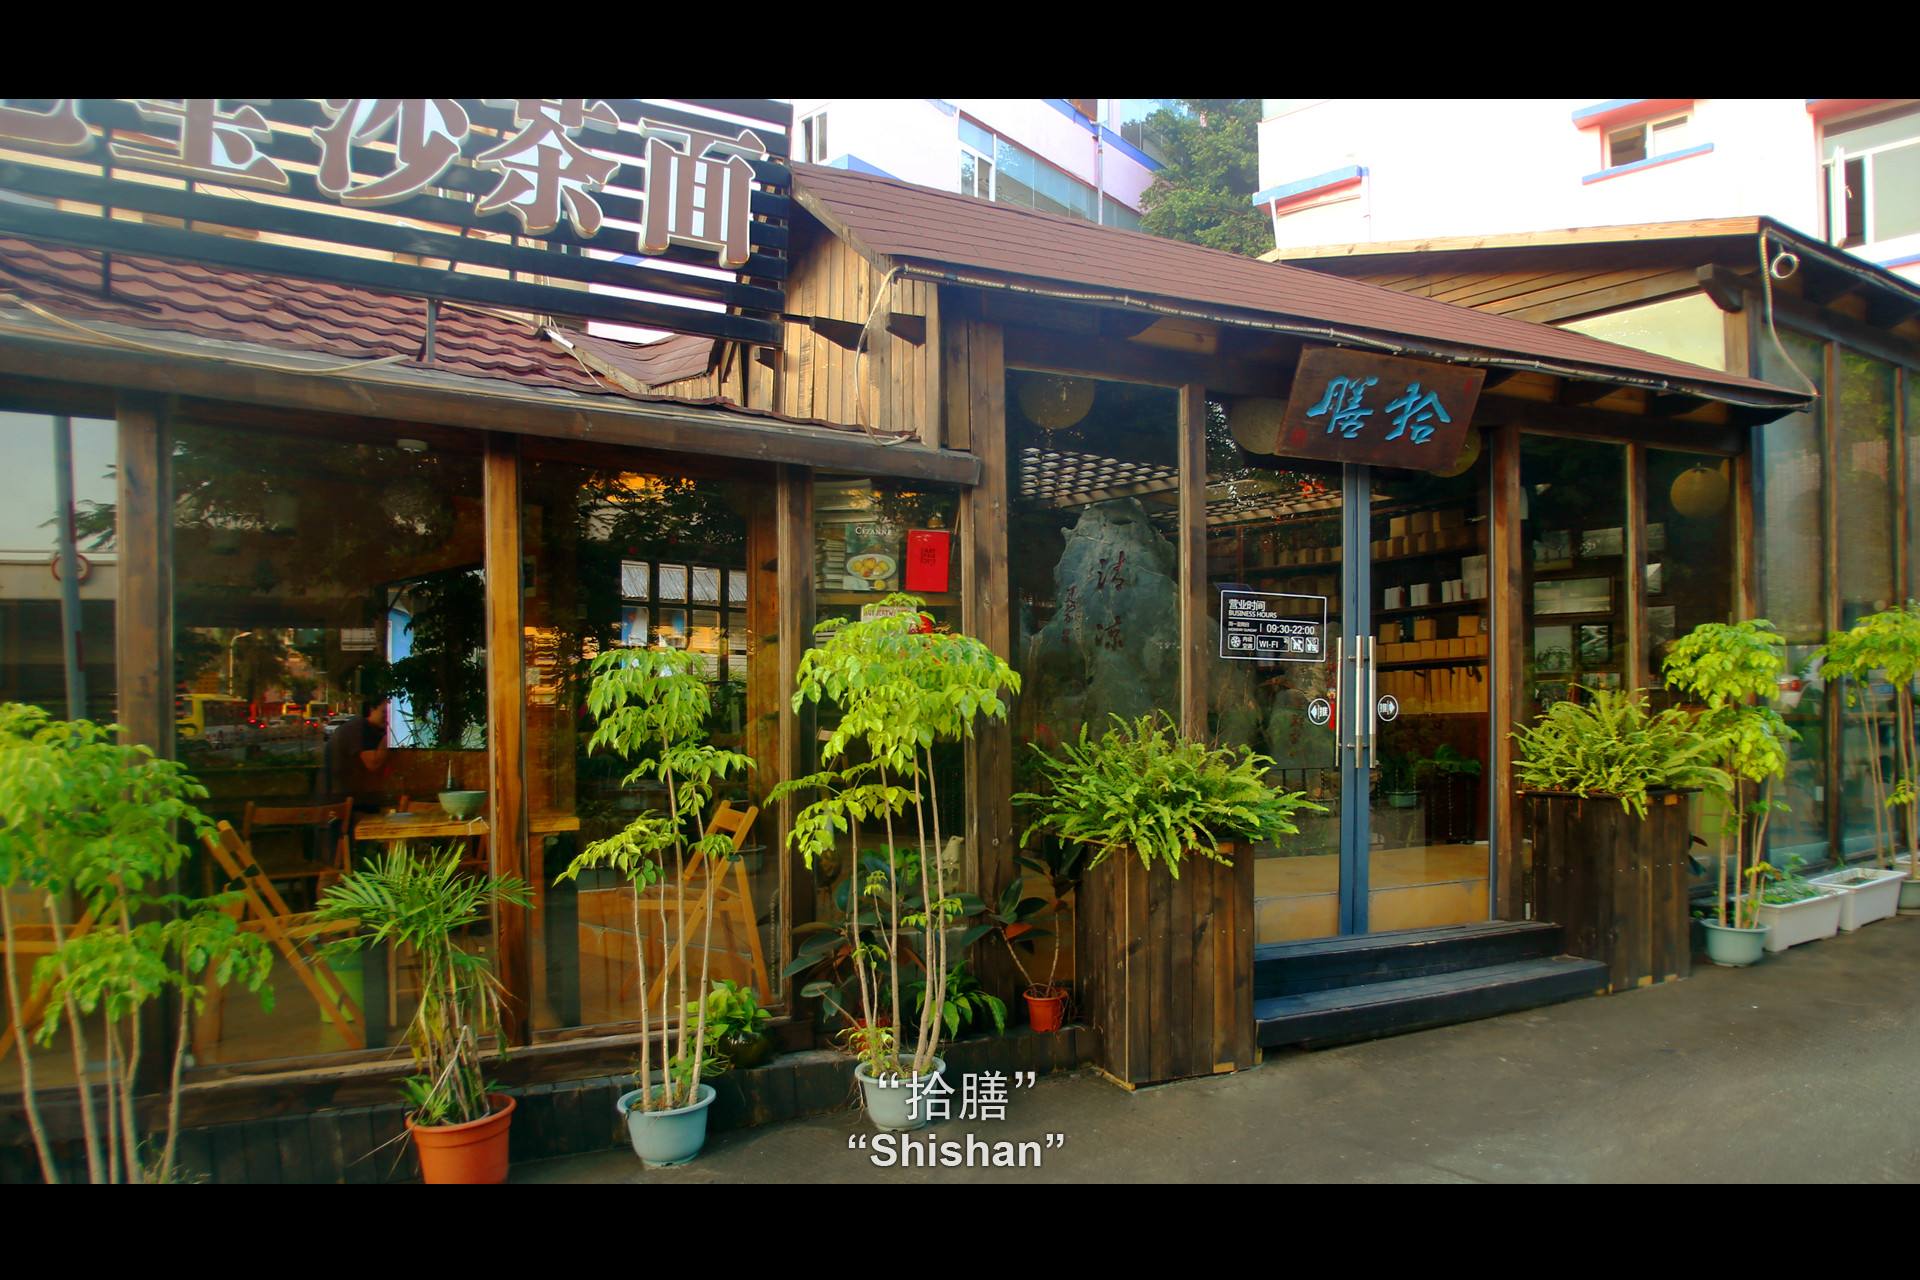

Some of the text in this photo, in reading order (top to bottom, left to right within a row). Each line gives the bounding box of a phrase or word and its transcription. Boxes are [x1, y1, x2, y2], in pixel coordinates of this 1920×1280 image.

[1228, 598, 1266, 612] 营业时间
[1228, 610, 1277, 619] BUSINESS HOURS
[1266, 623, 1315, 635] 09:30-22:00
[1258, 640, 1279, 648] WI-FI
